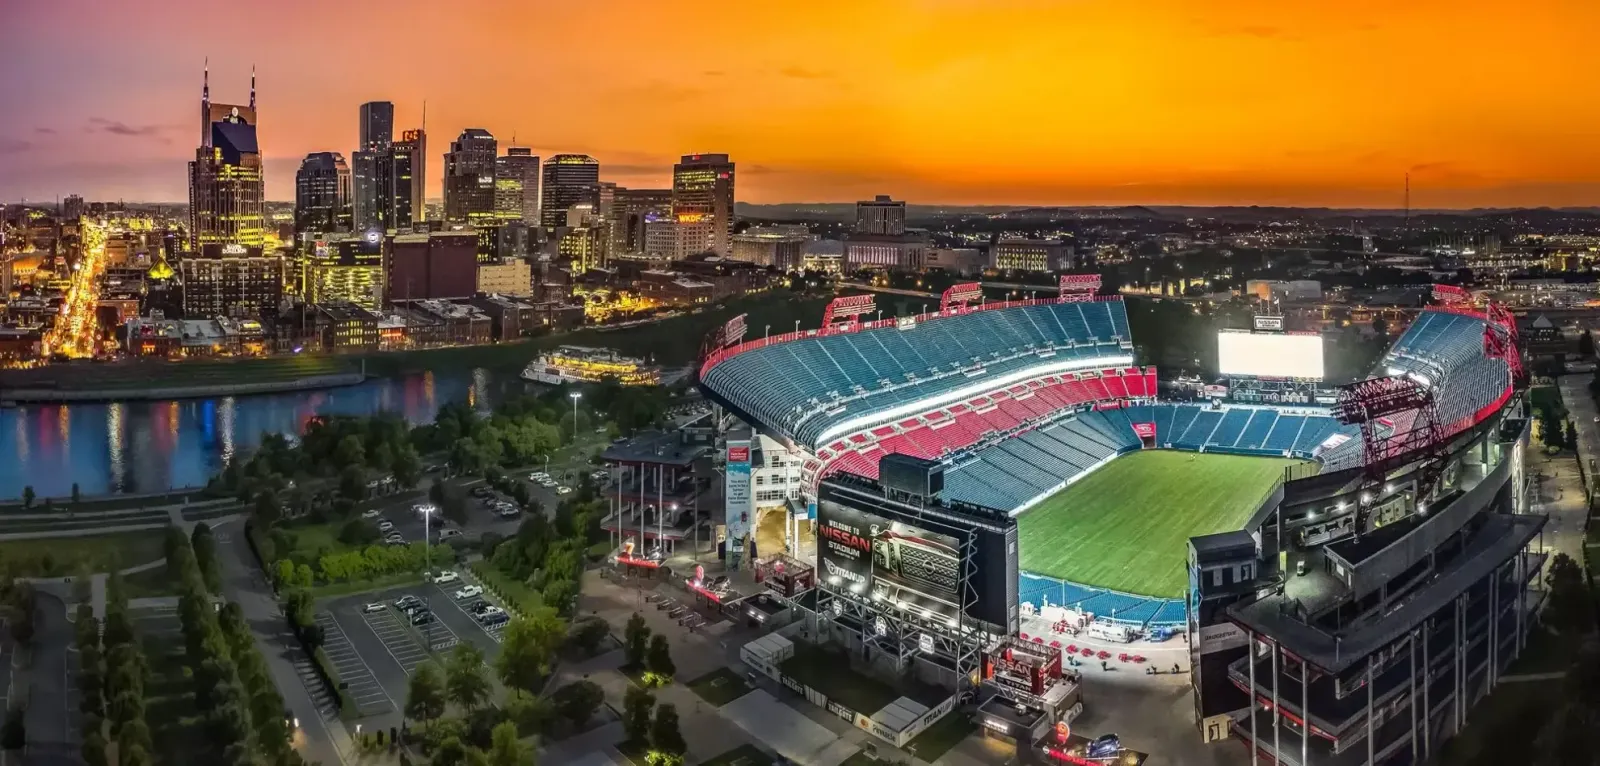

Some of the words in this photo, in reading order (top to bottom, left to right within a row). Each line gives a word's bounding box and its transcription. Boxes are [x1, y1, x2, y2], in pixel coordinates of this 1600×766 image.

[828, 519, 852, 532] WELCOME
[853, 527, 860, 536] TO
[820, 525, 870, 553] NISSAN
[828, 541, 860, 558] STADIUM
[988, 655, 1031, 677] NISSAN
[1006, 680, 1031, 692] TITAN
[872, 724, 896, 742] Pinnacle
